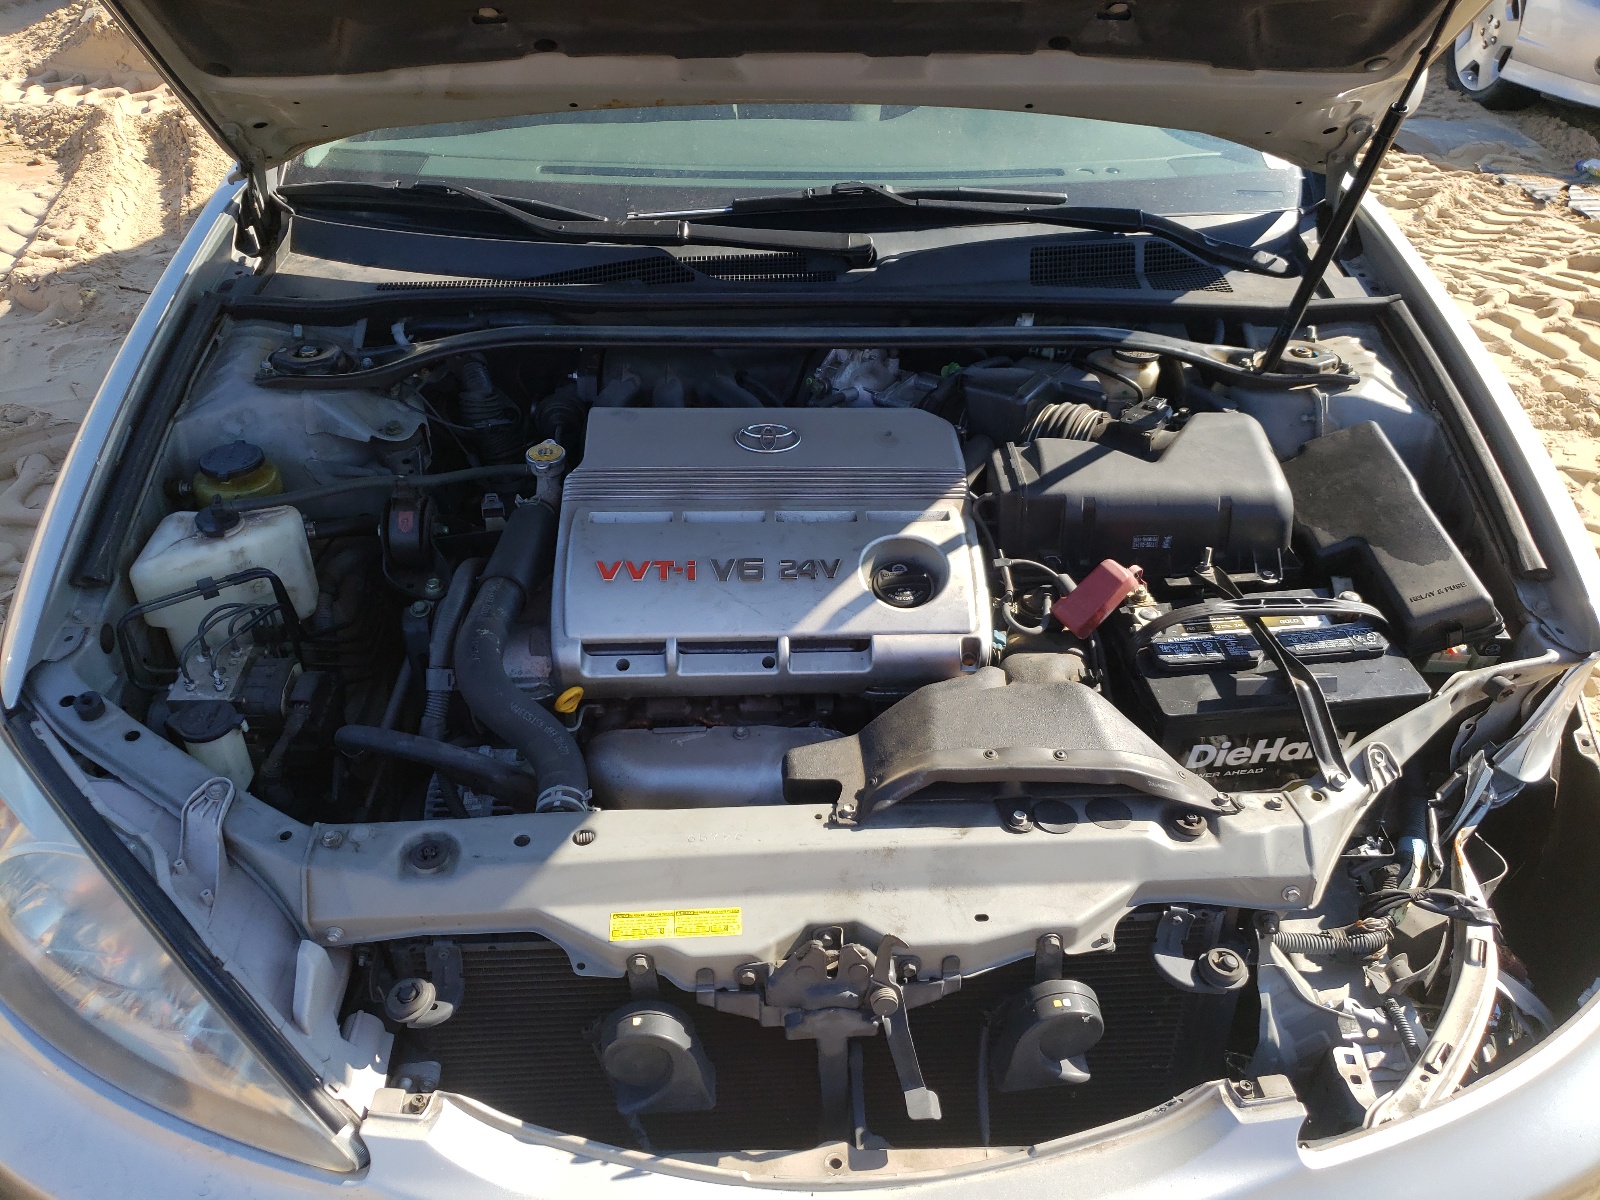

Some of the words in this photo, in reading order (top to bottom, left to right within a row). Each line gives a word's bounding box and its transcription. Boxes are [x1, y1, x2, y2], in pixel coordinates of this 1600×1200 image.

[596, 560, 697, 582] VVT-i
[710, 558, 765, 582] V6
[779, 558, 842, 581] 24V
[1409, 591, 1435, 602] RELAY
[1223, 767, 1264, 777] AHEAD
